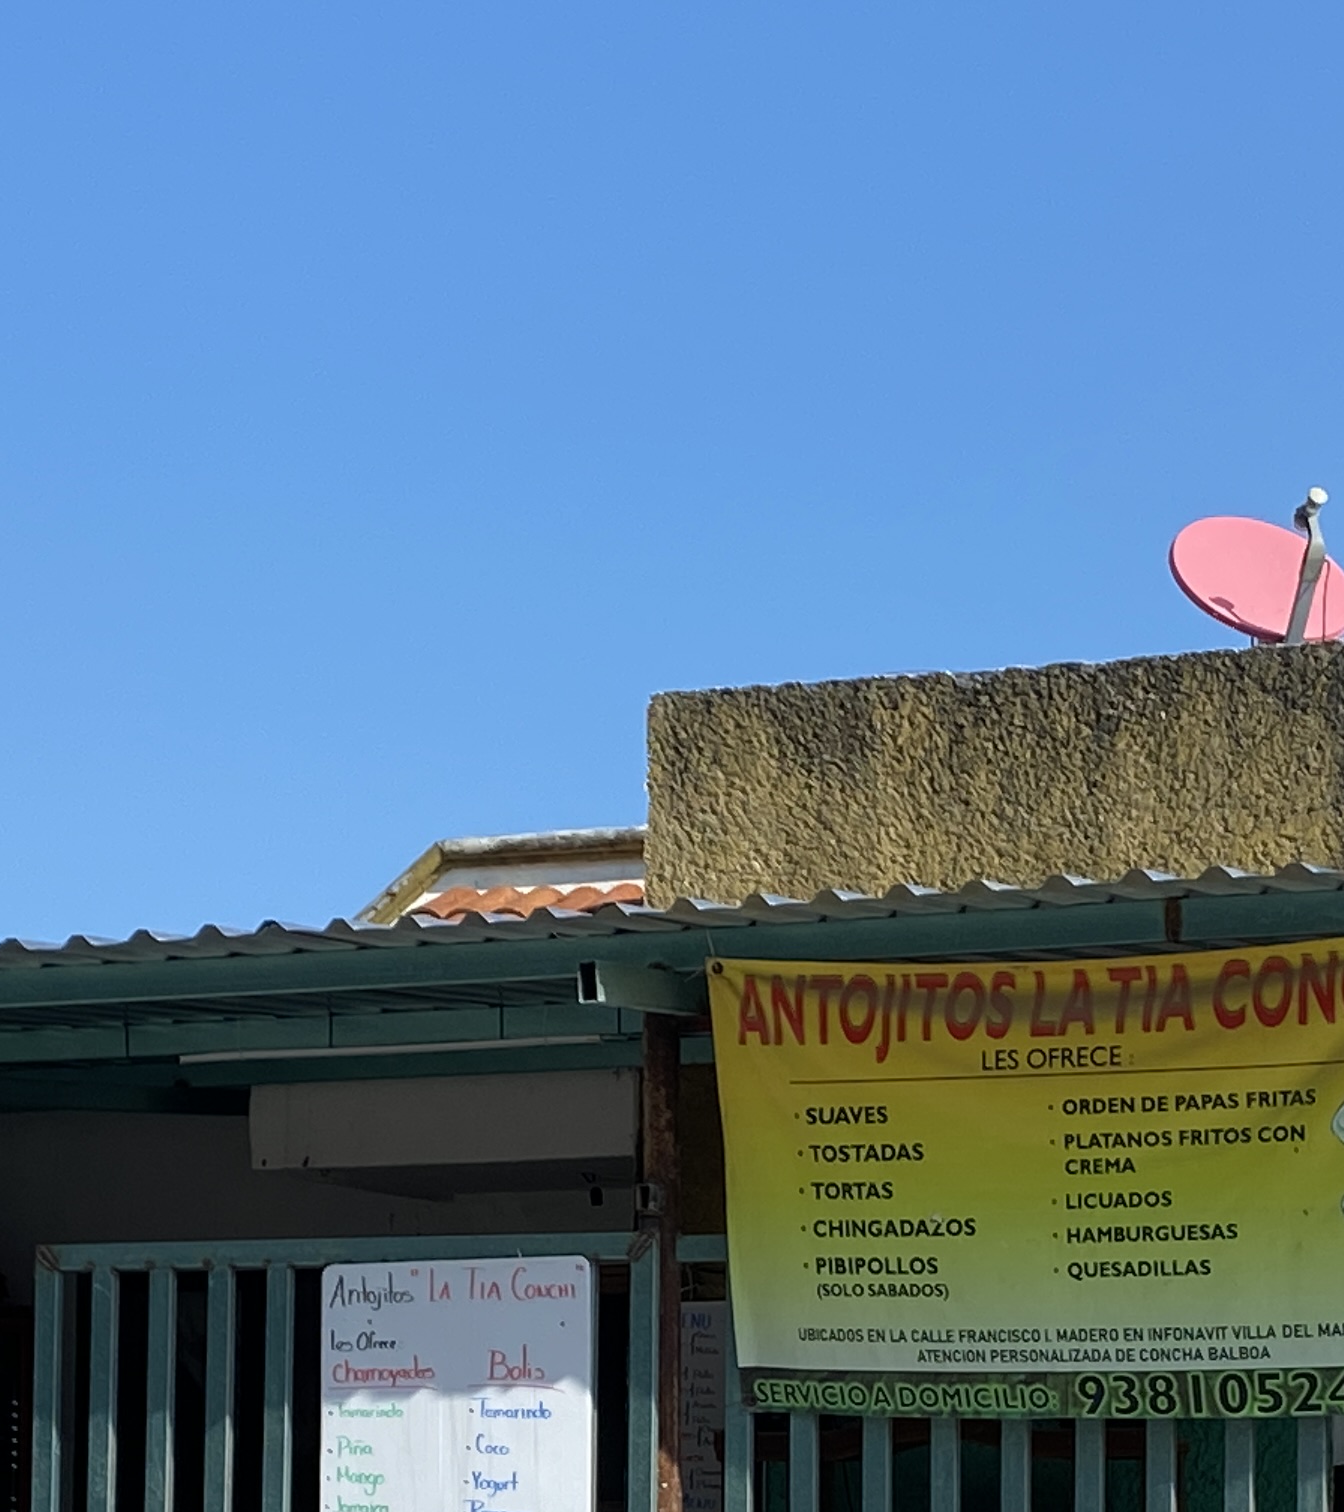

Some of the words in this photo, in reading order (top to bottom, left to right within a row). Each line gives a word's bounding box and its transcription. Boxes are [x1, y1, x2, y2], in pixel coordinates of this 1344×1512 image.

[738, 971, 1016, 1064] ANTOJITOS
[1030, 968, 1096, 1037] LA
[1107, 963, 1196, 1035] TIA
[981, 1048, 1019, 1072] LES
[1026, 1045, 1123, 1070] OFRECE
[1062, 1096, 1136, 1116] ORDEN
[1141, 1095, 1169, 1113] DE
[1174, 1093, 1240, 1112] PAPAS
[1246, 1089, 1317, 1109] FRITAS
[806, 1106, 889, 1125] SUAVES
[1064, 1130, 1173, 1150] PLATANOS
[1179, 1126, 1253, 1147] FRITOS
[1257, 1124, 1307, 1143] CON
[808, 1143, 925, 1163] TOSTADAS
[1064, 1157, 1137, 1176] CREMA
[810, 1181, 894, 1200] TORTAS
[1065, 1190, 1173, 1210] LICUADOS
[813, 1217, 977, 1238] CHINGADAZOS
[1066, 1223, 1239, 1244] HAMBURGUESAS
[815, 1256, 939, 1276] PIBIPOLLOS
[1067, 1259, 1212, 1281] QUESADILLAS
[329, 1271, 415, 1311] Antojitos
[817, 1283, 864, 1301] (SOLO
[868, 1283, 950, 1301] SABADOS)
[798, 1327, 865, 1343] UBICADOS
[868, 1328, 886, 1343] EN
[890, 1328, 907, 1343] LA
[911, 1328, 955, 1344] CALLE
[959, 1328, 1041, 1343] FRANCISCO
[1056, 1327, 1119, 1343] MADERO
[1124, 1327, 1144, 1342] EN
[1148, 1326, 1229, 1342] INFONAVIT
[1232, 1324, 1277, 1340] VILLA
[1282, 1323, 1313, 1339] DEL
[486, 1343, 546, 1382] Bolis
[917, 1348, 986, 1364] ATENCION
[990, 1348, 1112, 1364] PERSONALIZADA
[1116, 1347, 1136, 1363] DE
[1139, 1347, 1205, 1363] CONCHA
[1208, 1346, 1272, 1362] BALBOA
[755, 1381, 867, 1407] SERVICIO
[872, 1385, 892, 1408] A
[898, 1384, 1059, 1410] DOMICILIO:
[337, 1401, 404, 1420] Tamarindo
[469, 1396, 553, 1420] Tamarindo
[336, 1434, 374, 1459] Piña
[475, 1432, 511, 1456] Coco
[336, 1465, 386, 1497] Mango
[471, 1470, 520, 1498] Yogurt
